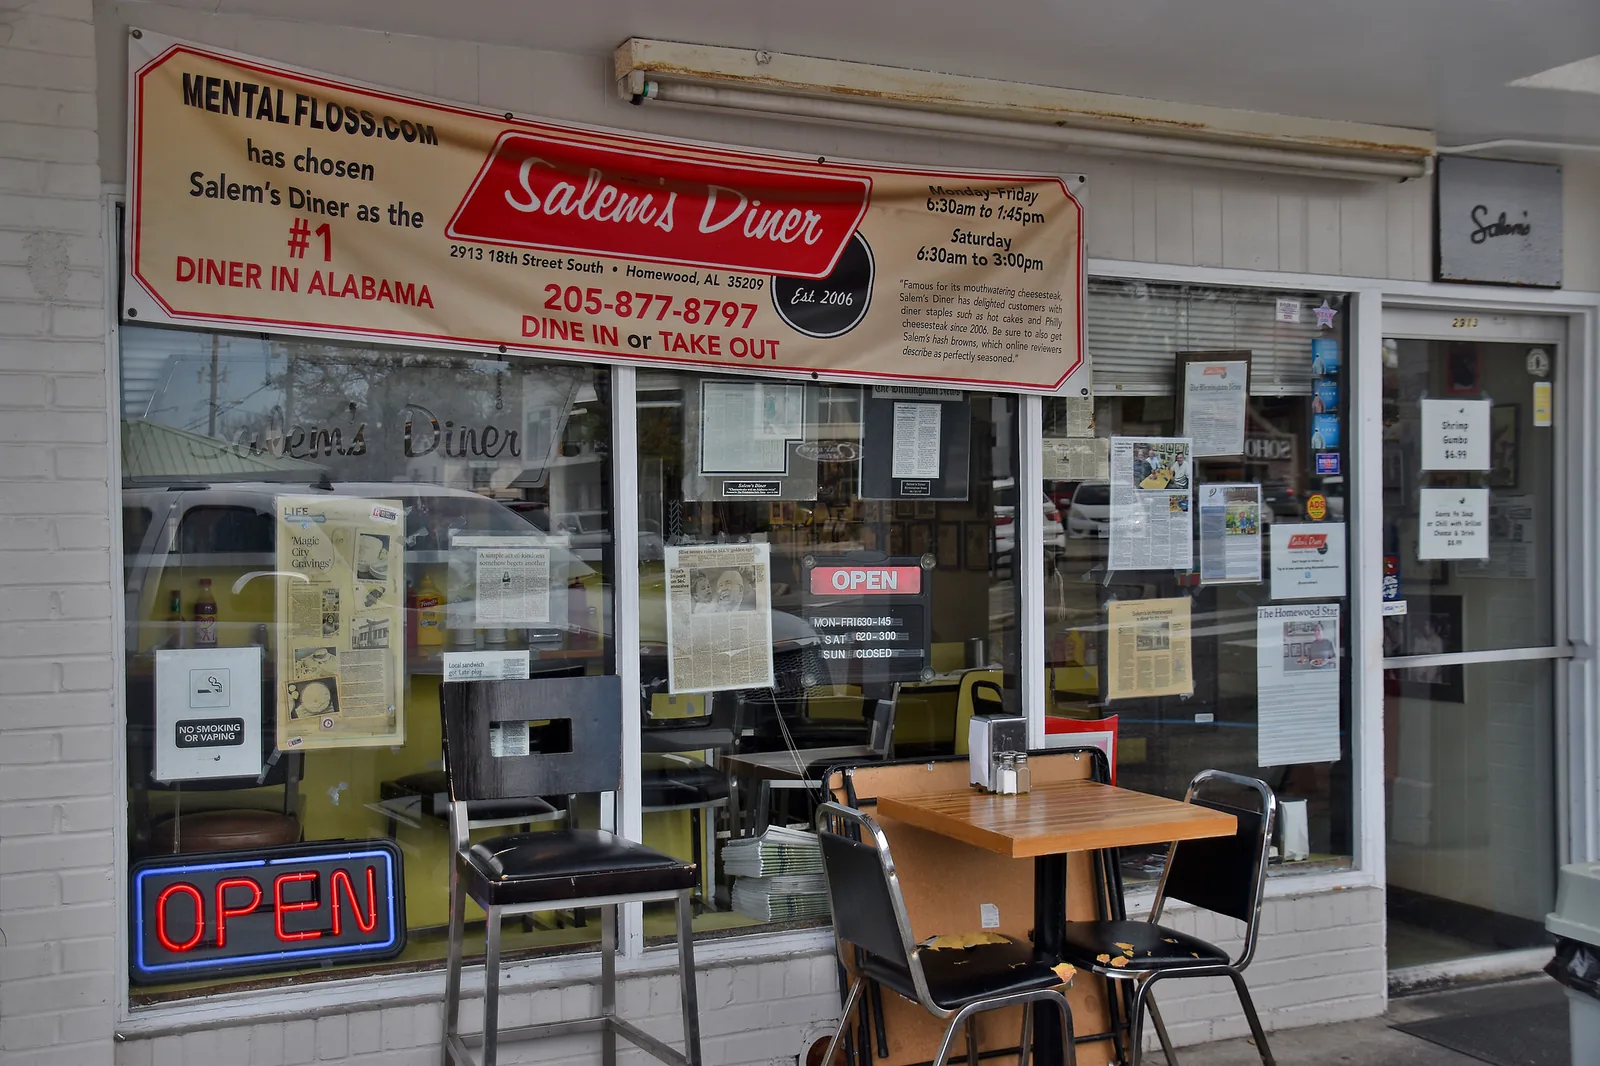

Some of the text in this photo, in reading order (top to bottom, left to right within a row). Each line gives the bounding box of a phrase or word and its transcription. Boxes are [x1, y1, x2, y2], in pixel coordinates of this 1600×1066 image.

[247, 138, 374, 181] has chosen
[190, 171, 424, 228] Salem's Diner as the
[504, 157, 823, 245] Salem's Diner
[927, 198, 1045, 226] 6:30am to 1:45pm
[287, 217, 332, 262] #1
[951, 229, 1012, 251] Saturday
[450, 245, 764, 290] 2913 18th Street South Homewood, AL 35209
[917, 246, 1043, 272] 6:30am to 3:00pm
[176, 256, 435, 308] DINER IN ALABAMA
[937, 282, 948, 290] for
[964, 284, 1016, 298] mouthwatering
[1018, 289, 1062, 301] cheesesteak,
[543, 284, 758, 328] 205-877-8797
[791, 288, 853, 307] Est. 2006
[900, 293, 1062, 314] Salem's Diner has delighted customers with
[901, 306, 921, 315] diner
[926, 307, 952, 319] staples
[957, 310, 972, 319] such
[987, 312, 999, 322] hot
[1003, 314, 1023, 324] cakes
[1028, 316, 1041, 325] and
[1045, 317, 1062, 329] Philly
[522, 315, 779, 360] DINE IN or TAKE OUT
[902, 319, 948, 331] cheesesteak
[950, 323, 967, 332] since
[970, 324, 989, 335] 2006.
[993, 327, 1002, 335] Be
[1035, 330, 1048, 339] also
[1051, 333, 1062, 342] get
[903, 332, 1062, 354] Salem's hash browns, which online reviewers
[903, 346, 932, 357] describe
[943, 350, 975, 363] perfectly
[404, 403, 521, 458] Diner
[1442, 421, 1468, 431] Shrimp
[1445, 450, 1467, 459] $6.99
[284, 507, 309, 516] LIFE
[1309, 501, 1325, 509] ADS
[292, 547, 310, 558] City
[832, 571, 897, 590] OPEN
[1259, 606, 1337, 619] The Homewood Star
[825, 635, 846, 644] SAT
[823, 649, 892, 659] SUN CLOSED
[449, 661, 461, 669] Local
[179, 723, 241, 734] NO SMOKING
[185, 732, 235, 742] OR VAPING
[155, 865, 378, 953] OPEN
